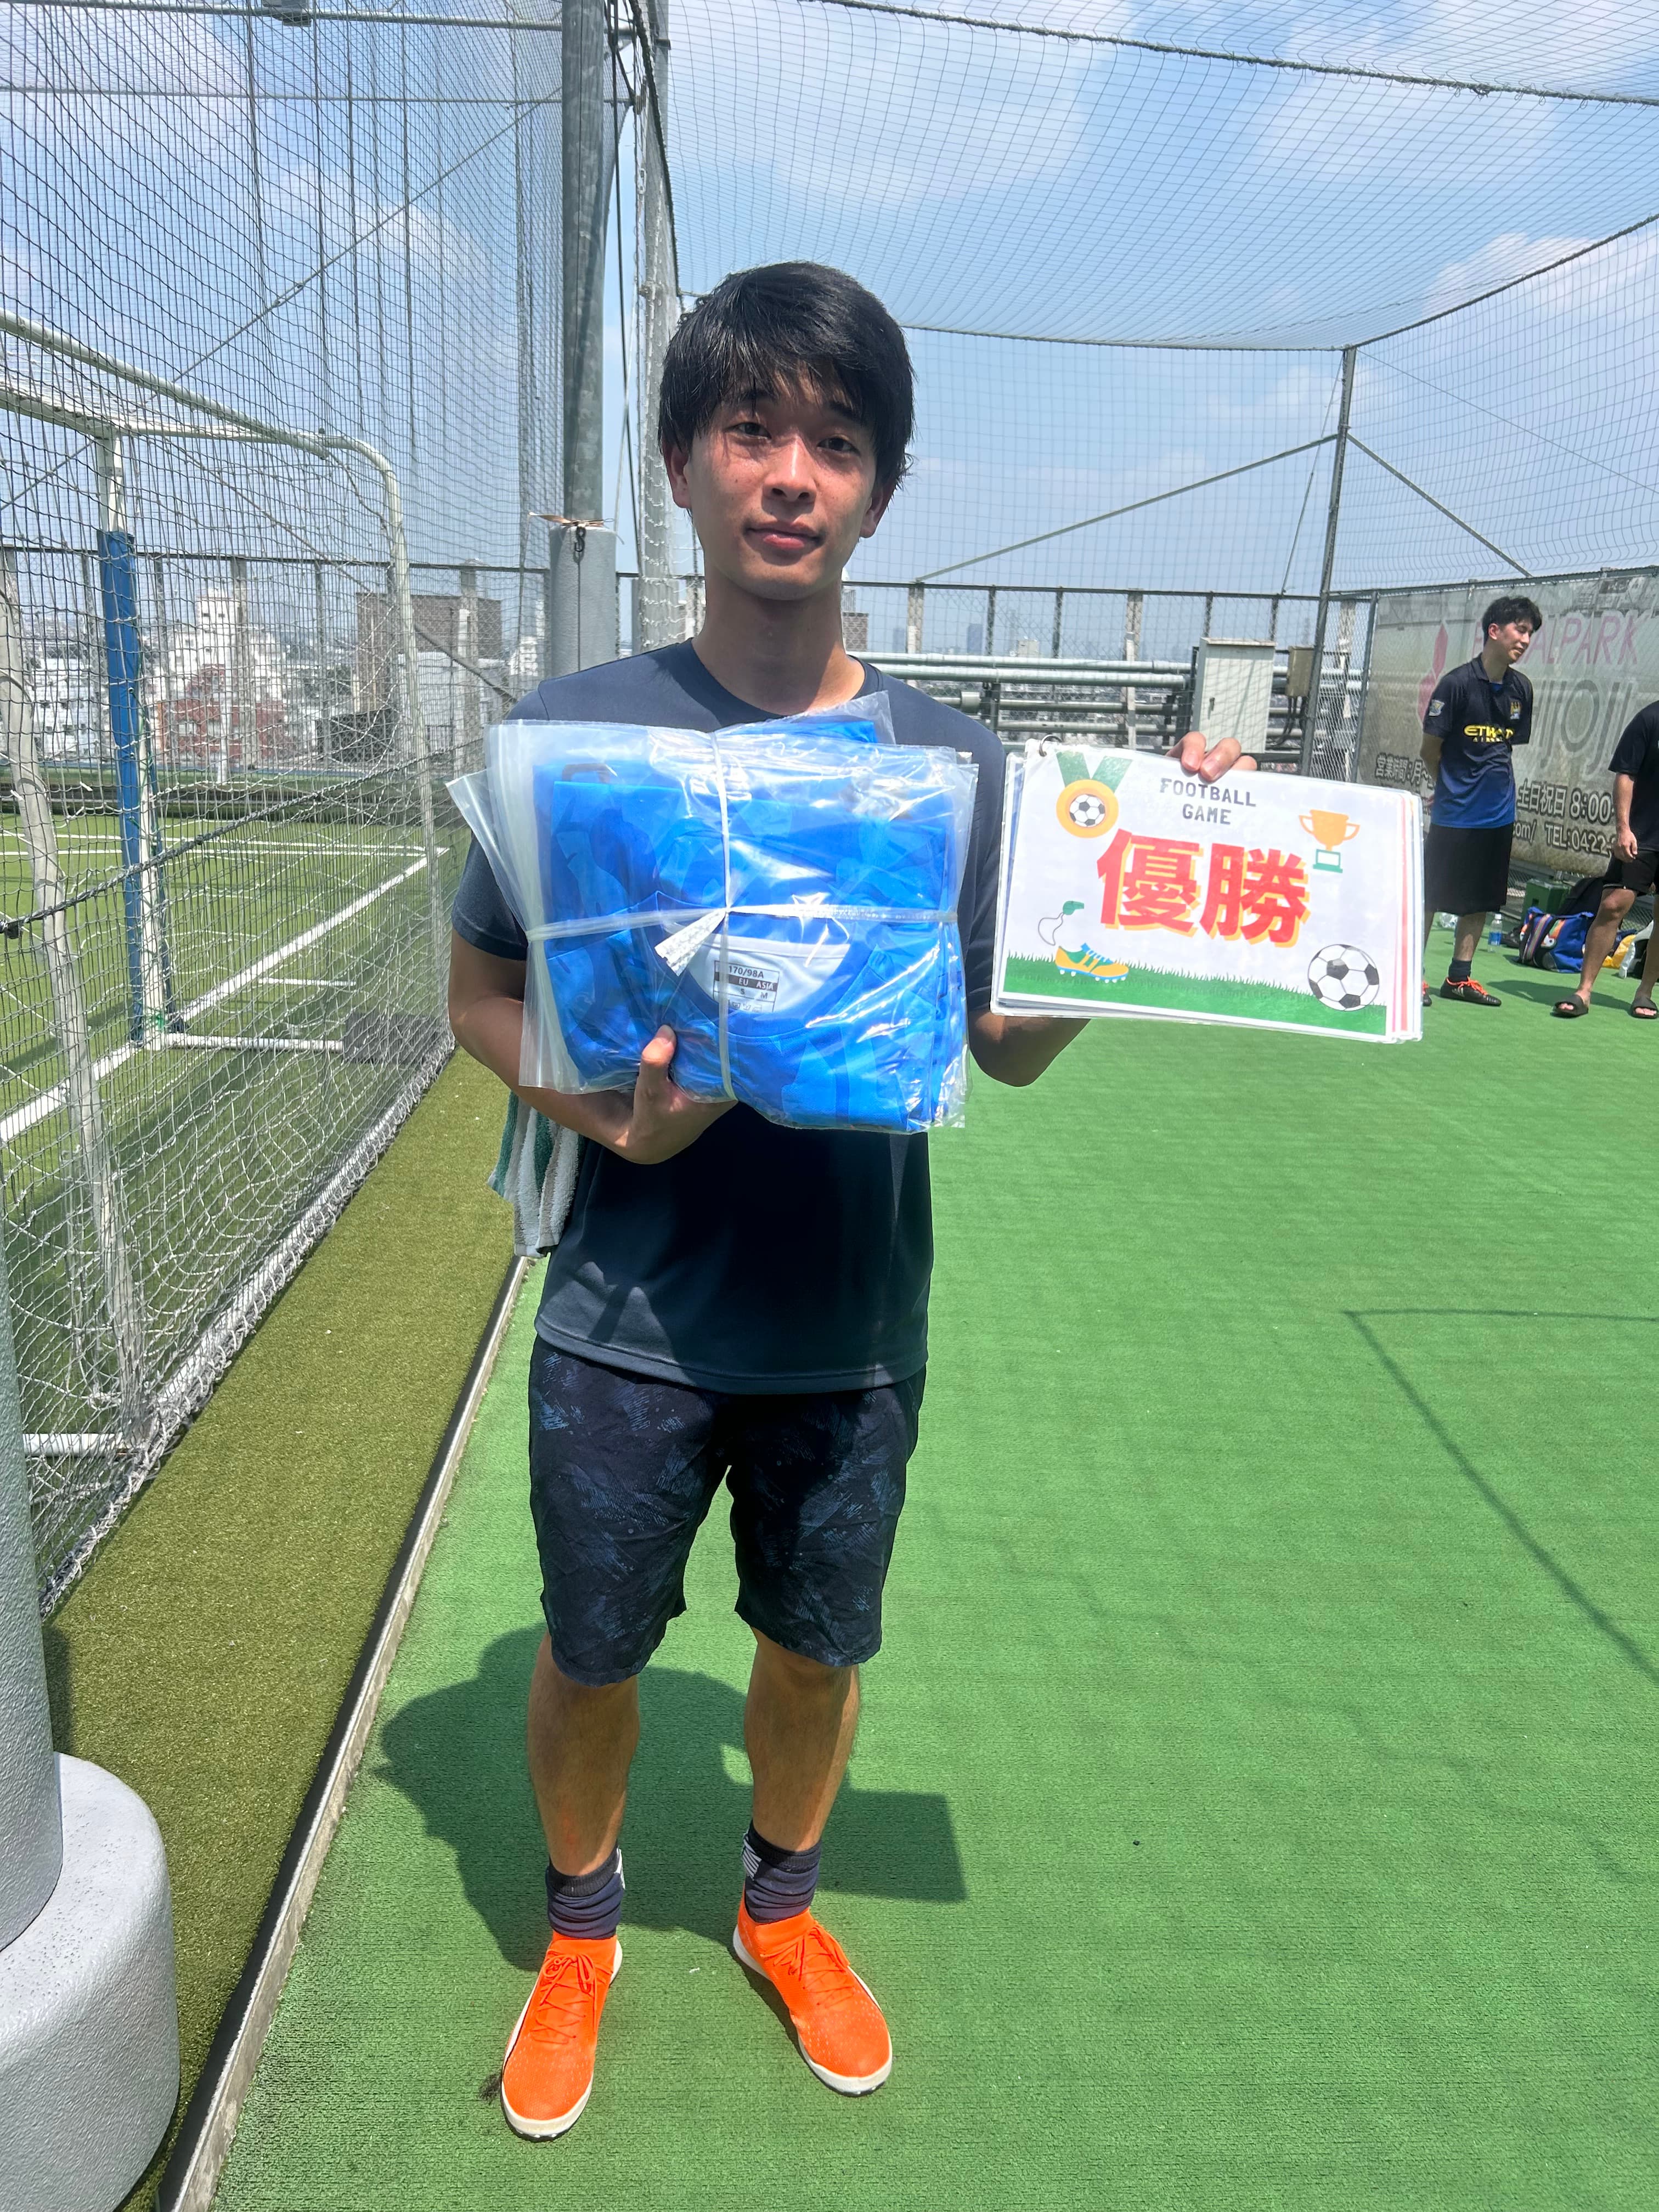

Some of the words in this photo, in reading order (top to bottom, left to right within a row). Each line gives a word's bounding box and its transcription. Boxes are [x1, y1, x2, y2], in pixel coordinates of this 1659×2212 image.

[1160, 777, 1256, 807] FOOTBALL
[1517, 781, 1567, 816] 土日祝日
[1182, 803, 1231, 825] GAME
[1096, 828, 1311, 948] 優勝
[729, 966, 764, 979] 170/98A
[738, 978, 749, 986] EU
[756, 981, 774, 990] ASIA
